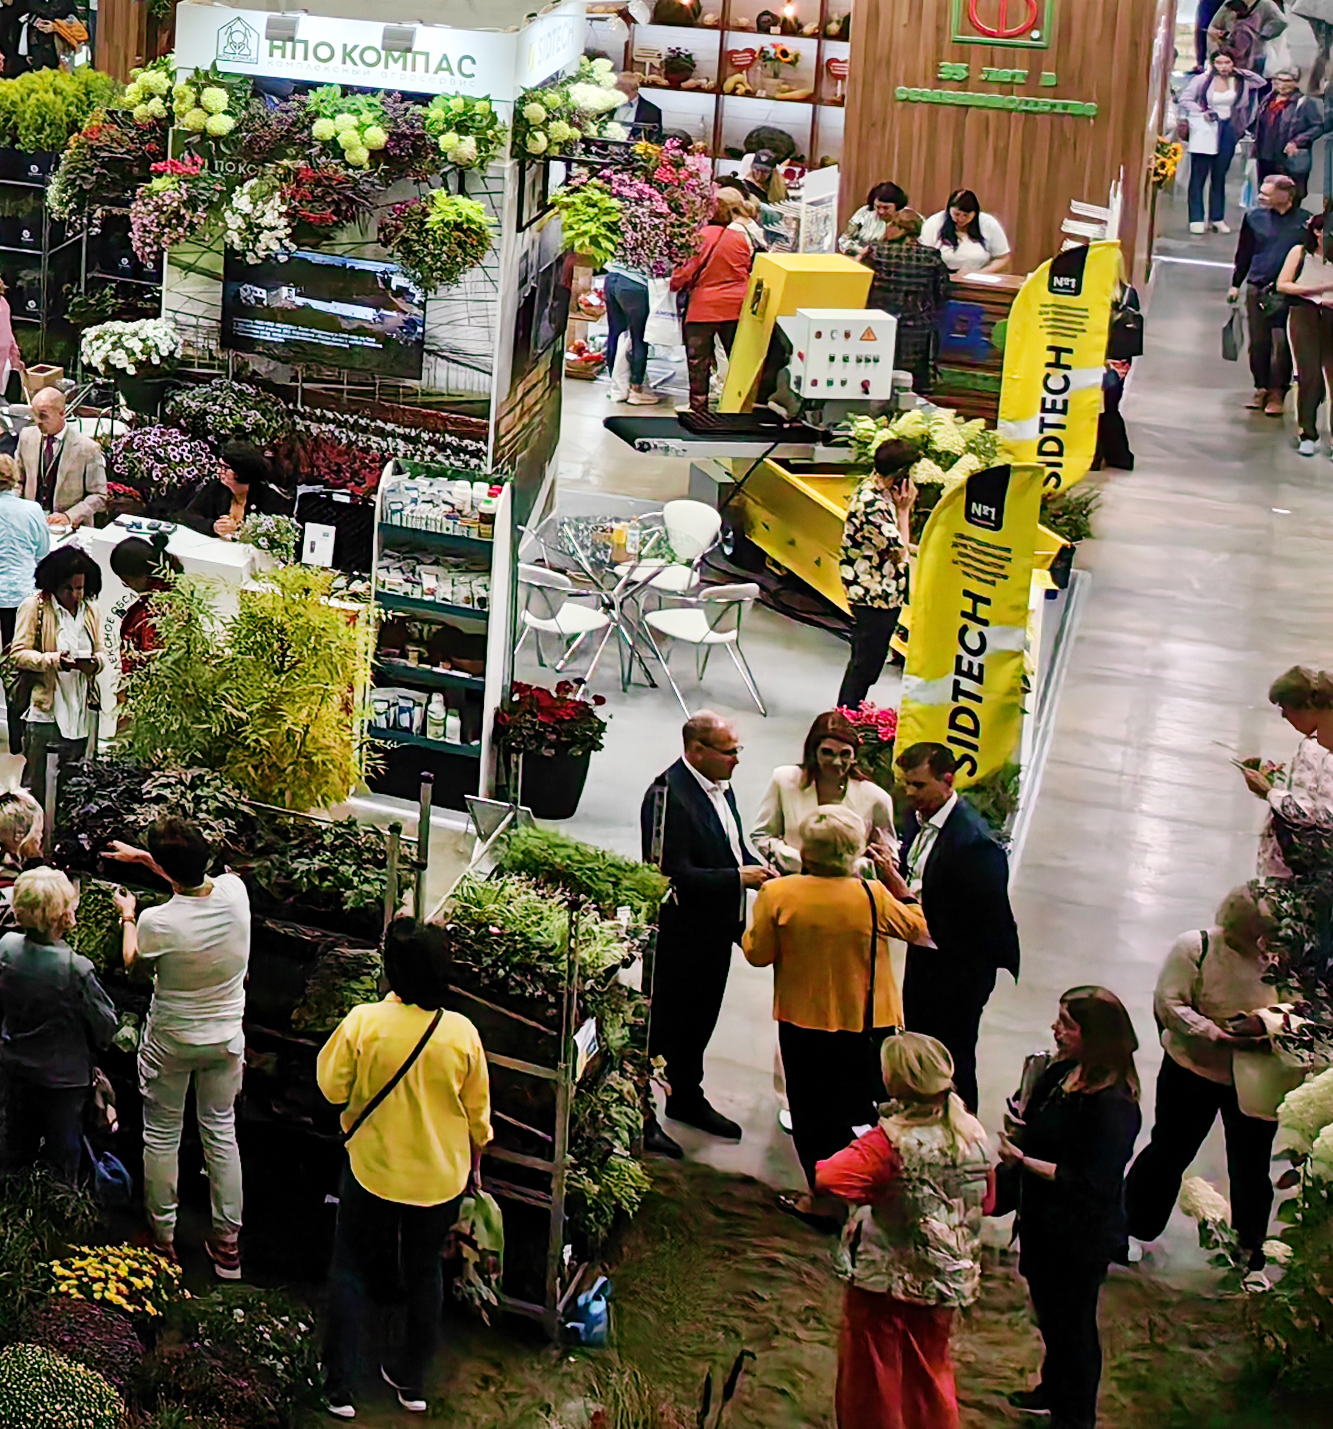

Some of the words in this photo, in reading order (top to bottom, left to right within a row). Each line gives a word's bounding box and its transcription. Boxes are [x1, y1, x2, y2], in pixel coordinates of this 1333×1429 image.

[267, 39, 335, 65] НПО
[342, 43, 477, 80] КОМПАС
[267, 60, 371, 78] комплексный
[379, 71, 477, 89] агросервис
[1036, 344, 1074, 489] SIDTECH
[946, 588, 993, 778] SIDTECH
